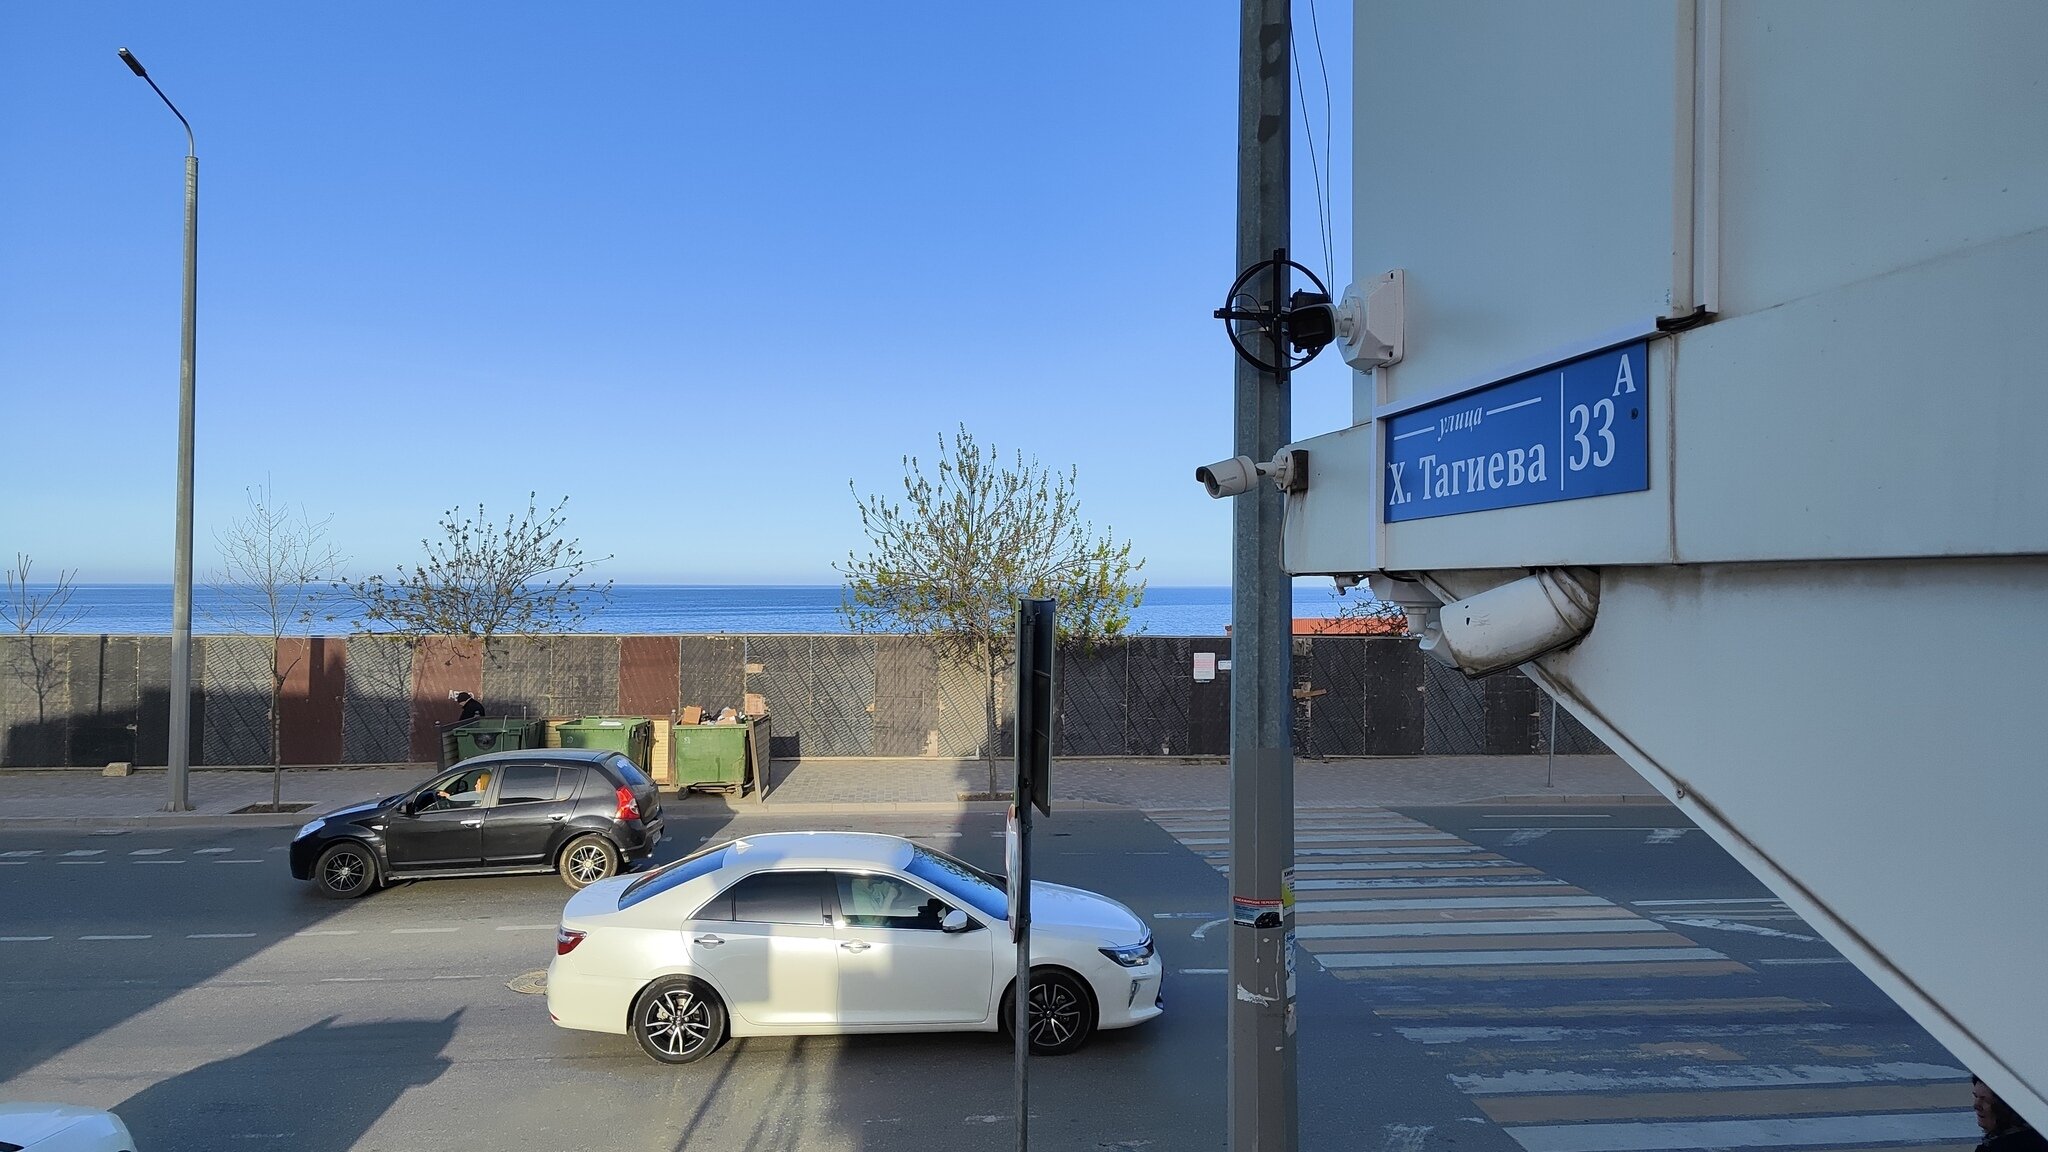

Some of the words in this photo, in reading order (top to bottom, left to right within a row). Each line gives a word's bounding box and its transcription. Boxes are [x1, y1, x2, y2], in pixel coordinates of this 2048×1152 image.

[1612, 353, 1636, 397] А
[1437, 405, 1483, 441] улица
[1569, 398, 1616, 471] 33
[1388, 459, 1412, 505] Х.
[1419, 443, 1547, 500] Тагиева
